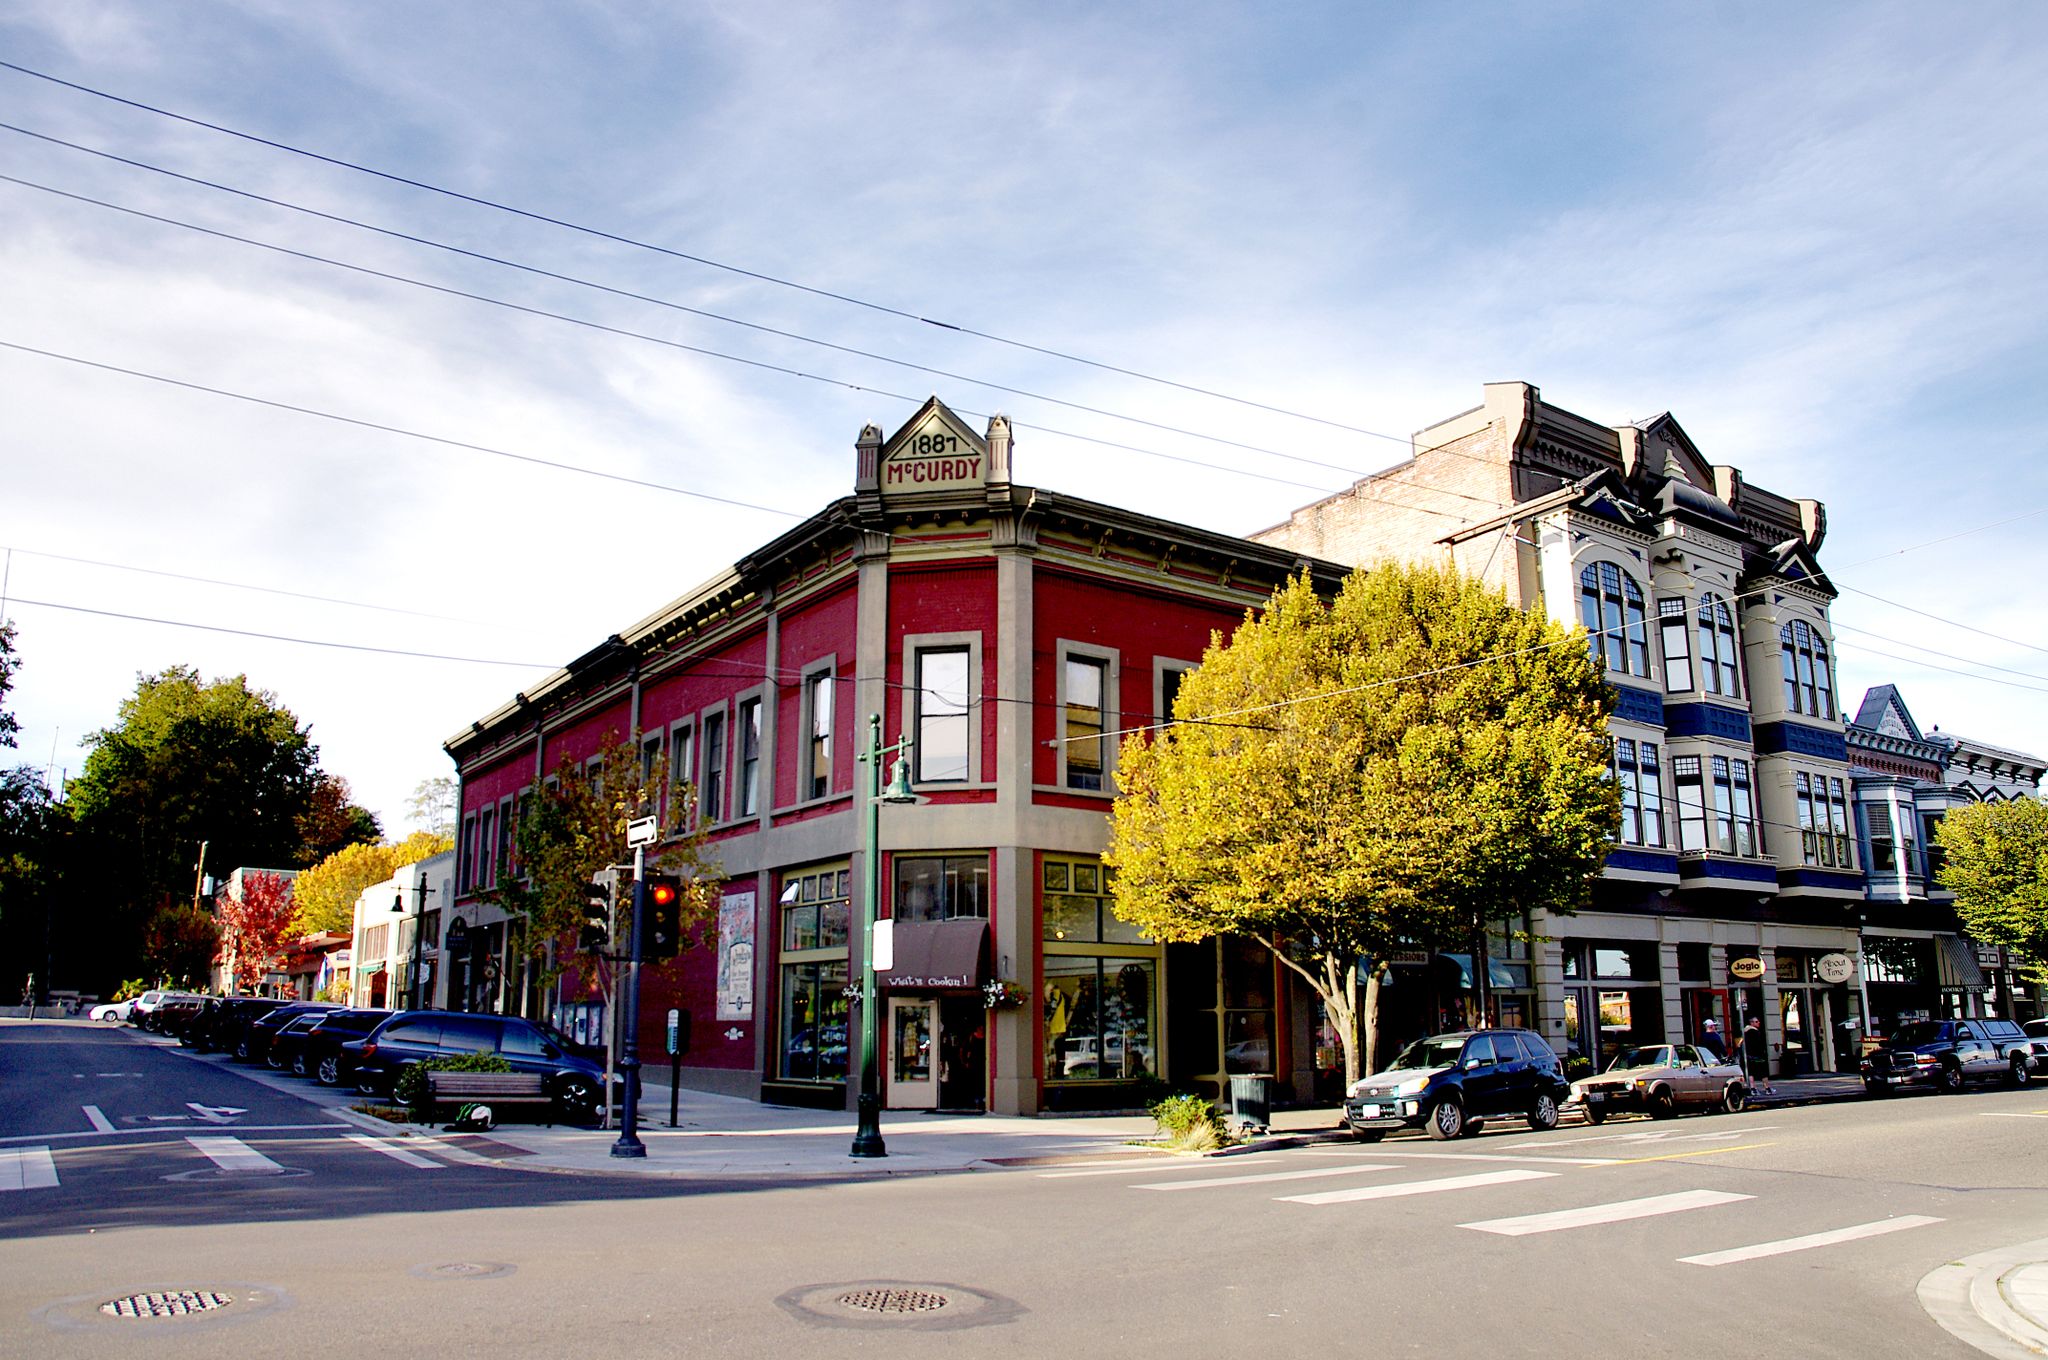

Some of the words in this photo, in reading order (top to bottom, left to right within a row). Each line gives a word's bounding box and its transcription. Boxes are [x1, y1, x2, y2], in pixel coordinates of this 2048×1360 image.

[912, 434, 957, 455] 1887
[887, 458, 981, 484] McCURDY
[1734, 962, 1760, 971] Joglo
[1824, 959, 1846, 970] About
[1826, 968, 1844, 976] Time
